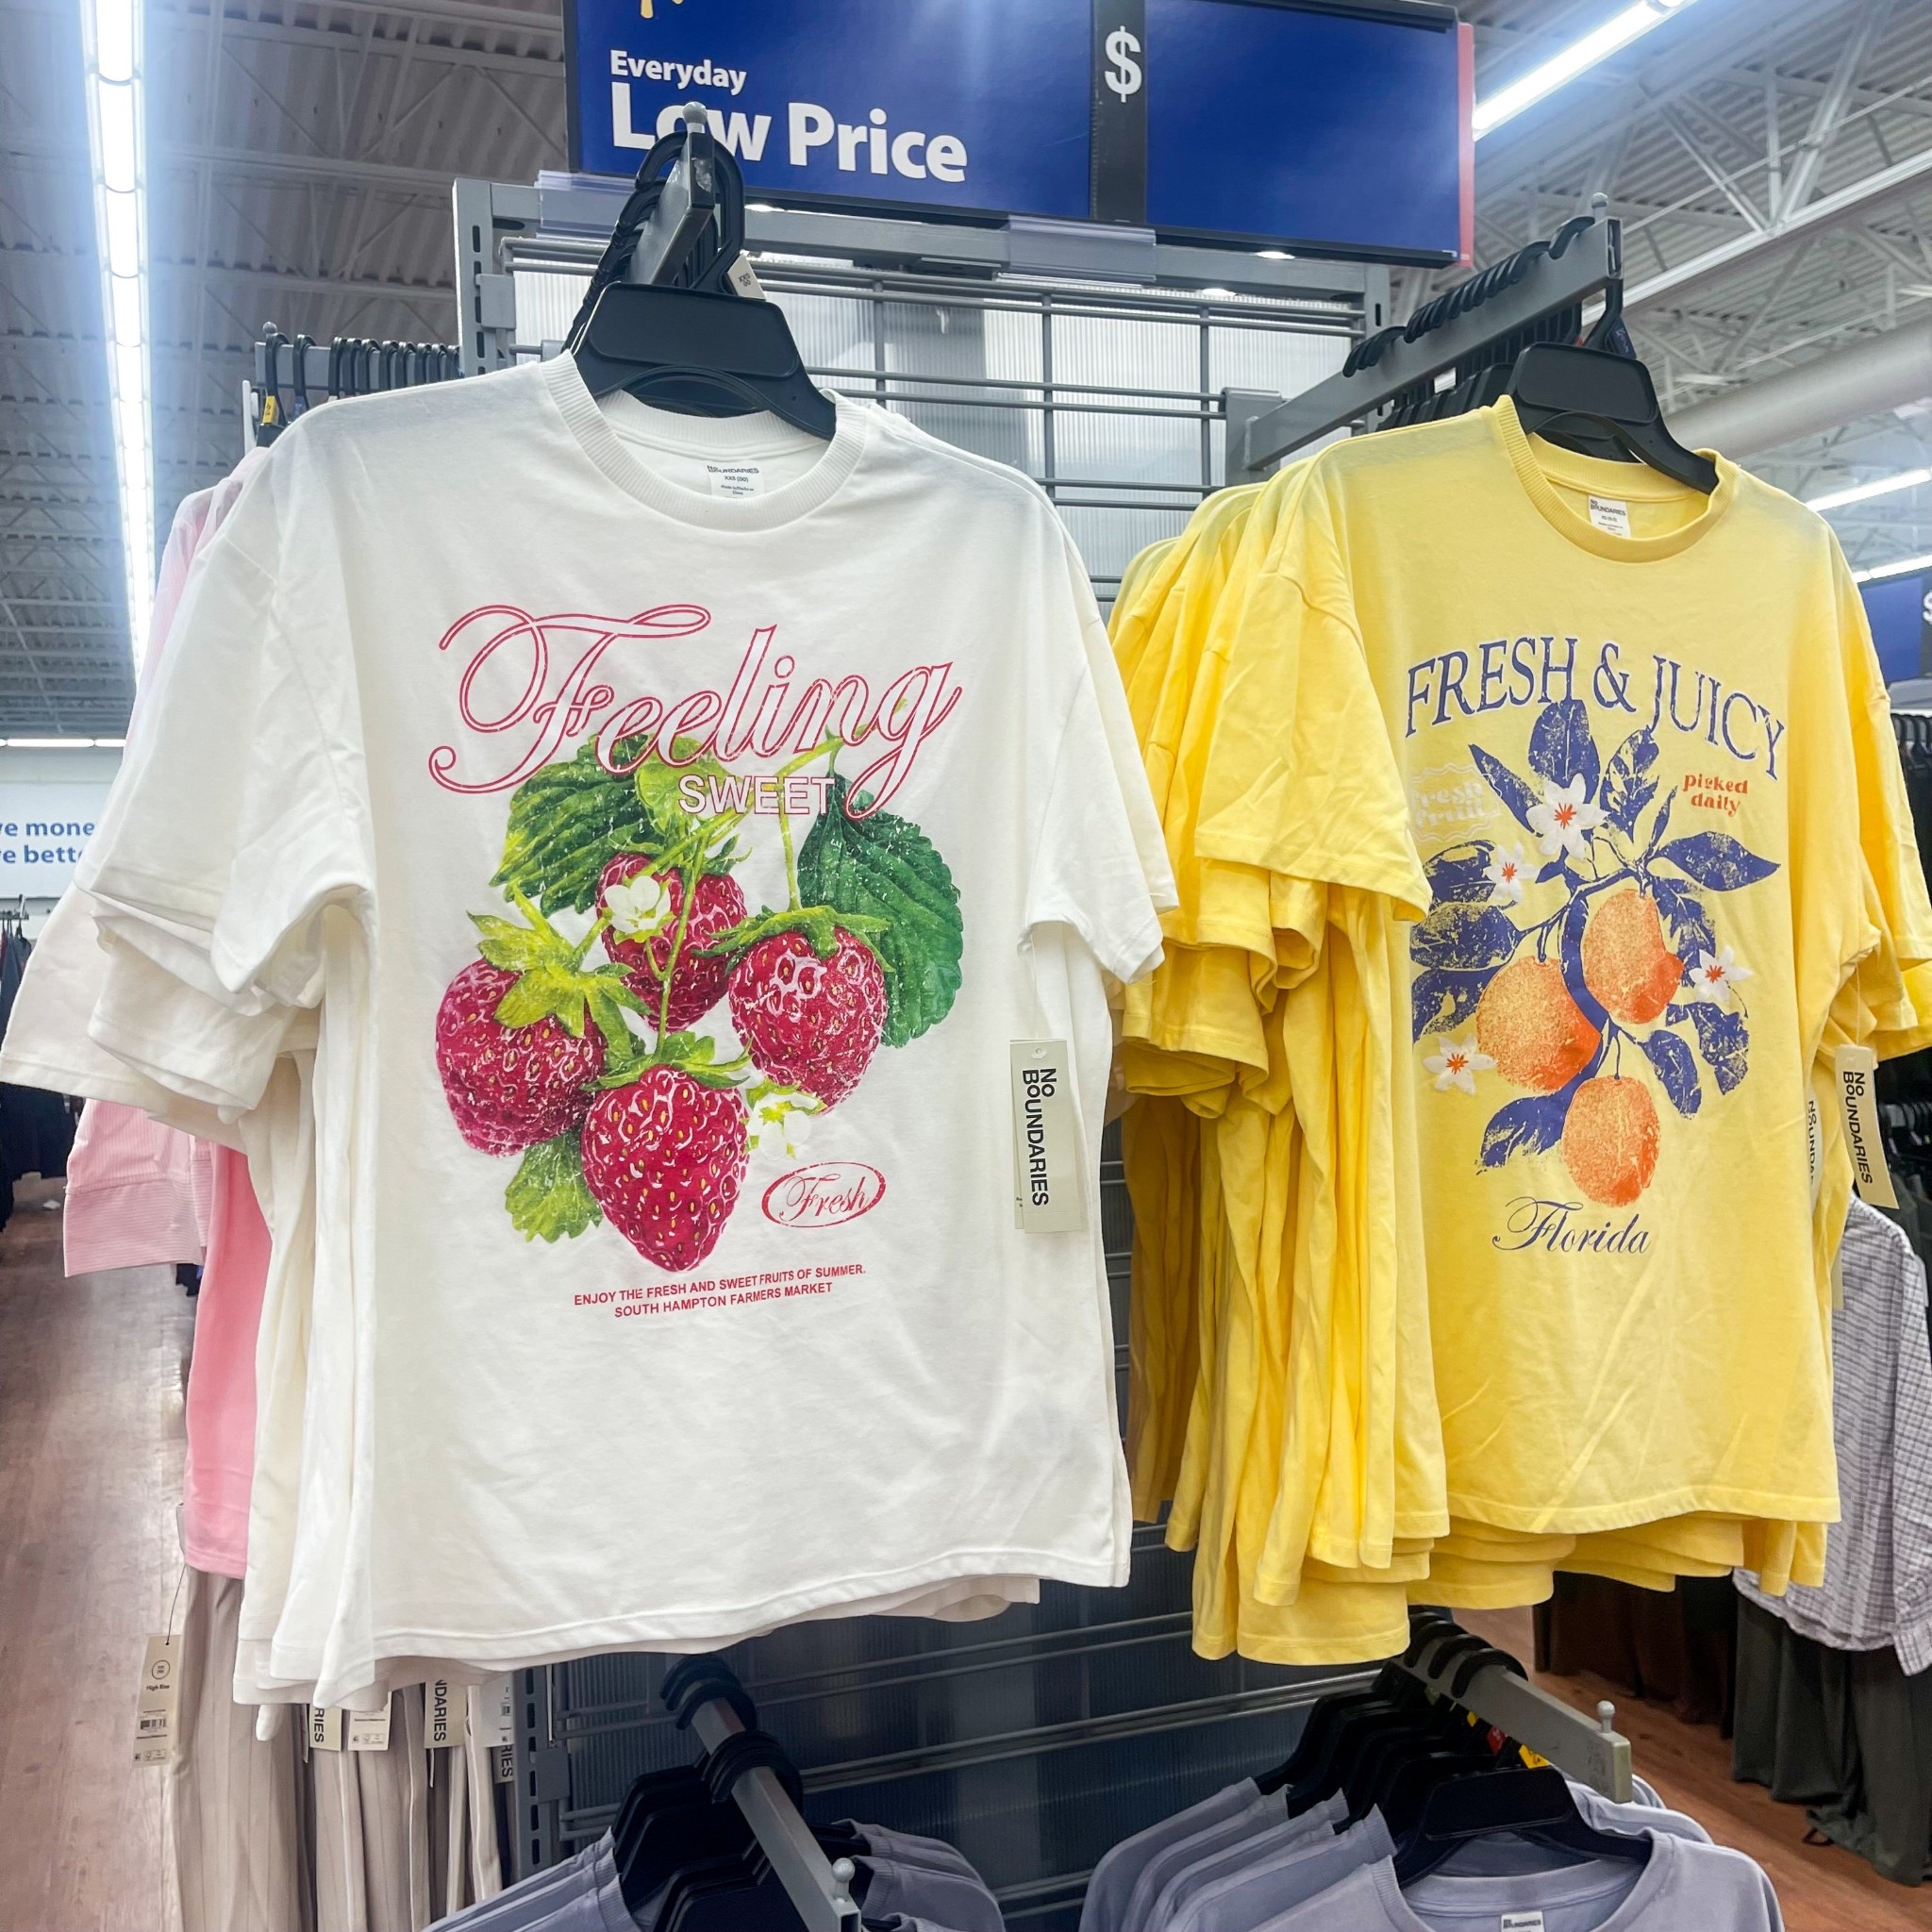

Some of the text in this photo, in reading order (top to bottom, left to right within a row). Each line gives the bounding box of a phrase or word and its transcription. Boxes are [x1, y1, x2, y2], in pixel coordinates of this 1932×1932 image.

[610, 49, 747, 96] Everyday
[788, 101, 968, 183] Price
[428, 604, 963, 821] Feeling
[1405, 636, 1786, 781] FRESH & JUICY
[677, 774, 836, 816] SWEET
[1682, 773, 1748, 794] picked
[1690, 792, 1740, 818] daily
[24, 843, 83, 863] bett
[1040, 1068, 1058, 1098] NO
[1854, 1072, 1866, 1097] NO
[1022, 1069, 1049, 1207] BOUNDARIES
[1843, 1071, 1874, 1185] BOUNDARIES
[778, 1173, 870, 1223] Fresh
[1491, 1196, 1652, 1254] Florida
[574, 1263, 866, 1306] ENJOY THE FRESH AND SWEET FRUITS OF SUMMER.
[614, 1281, 834, 1318] SOUTH HAMPTON FARMERS MARKET
